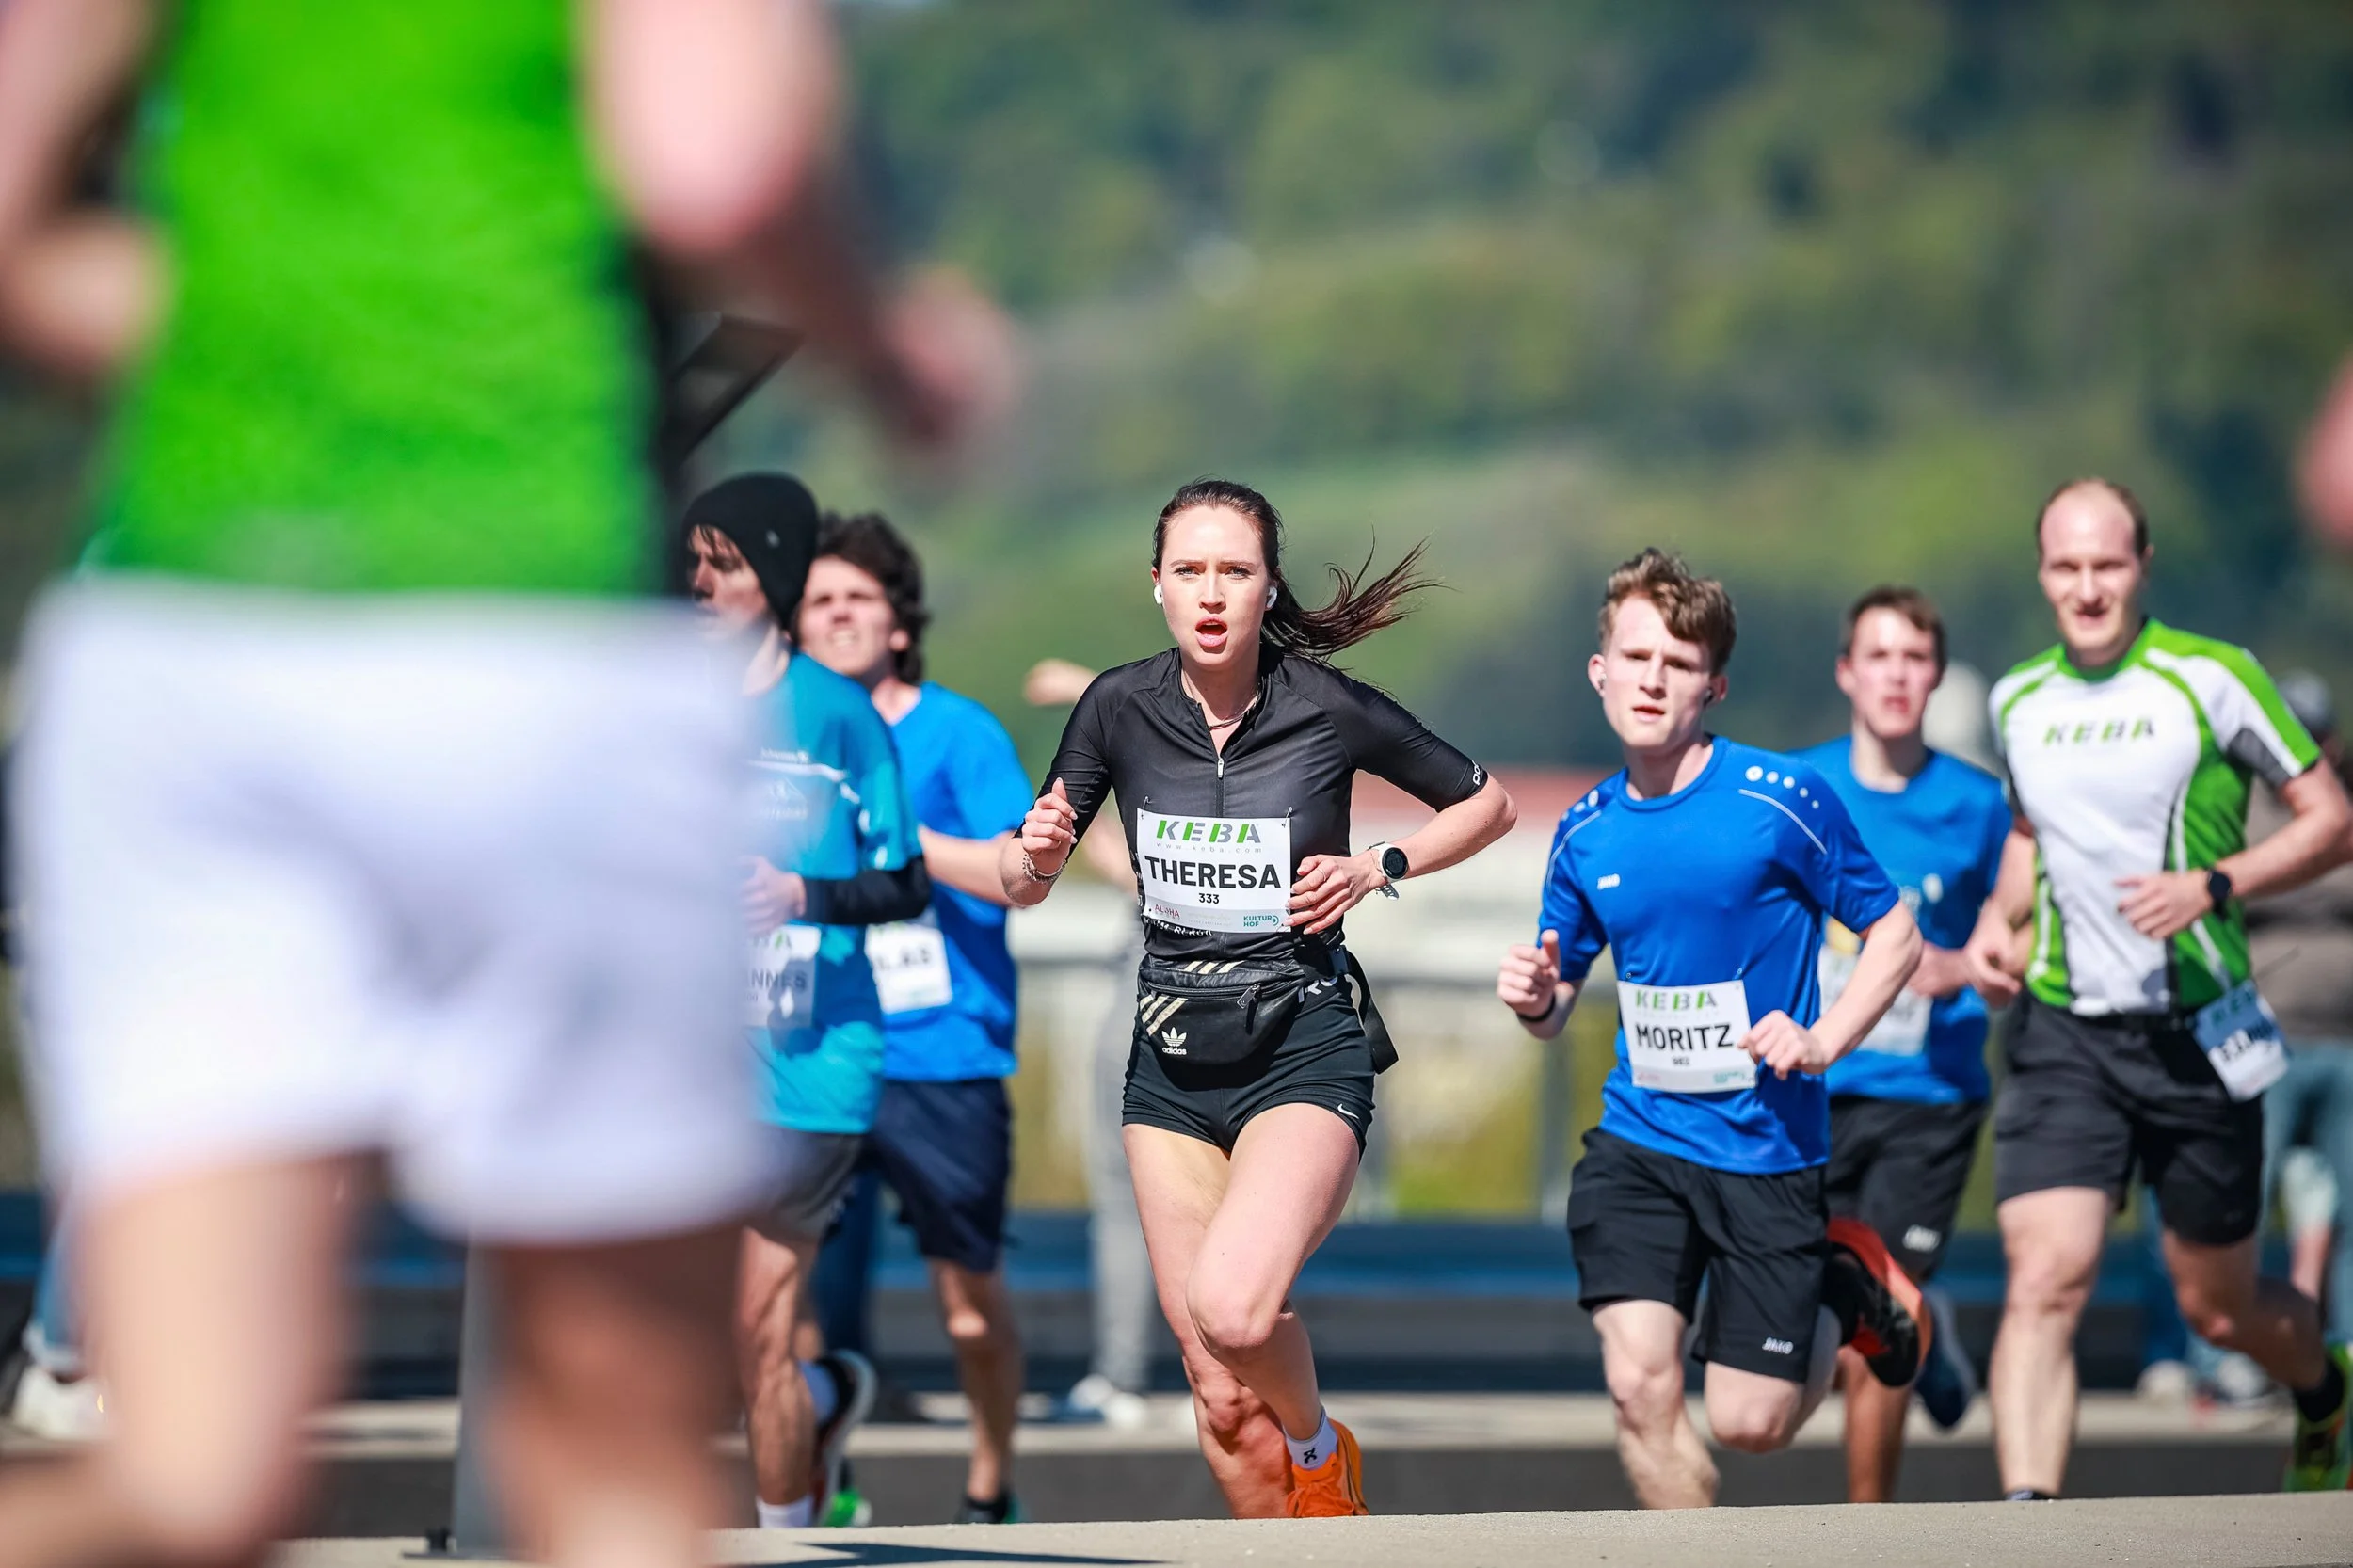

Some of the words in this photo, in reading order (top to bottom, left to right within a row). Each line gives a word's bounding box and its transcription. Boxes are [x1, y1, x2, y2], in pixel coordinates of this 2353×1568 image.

[2042, 718, 2155, 746] KEBA
[1156, 820, 1261, 844] KEBA
[1144, 855, 1281, 889] THERESA
[1198, 892, 1220, 904] 333
[751, 968, 808, 993] NNES
[1635, 989, 1719, 1011] KEBA
[1636, 1023, 1735, 1052] MORITZ
[1161, 1046, 1187, 1055] adidas
